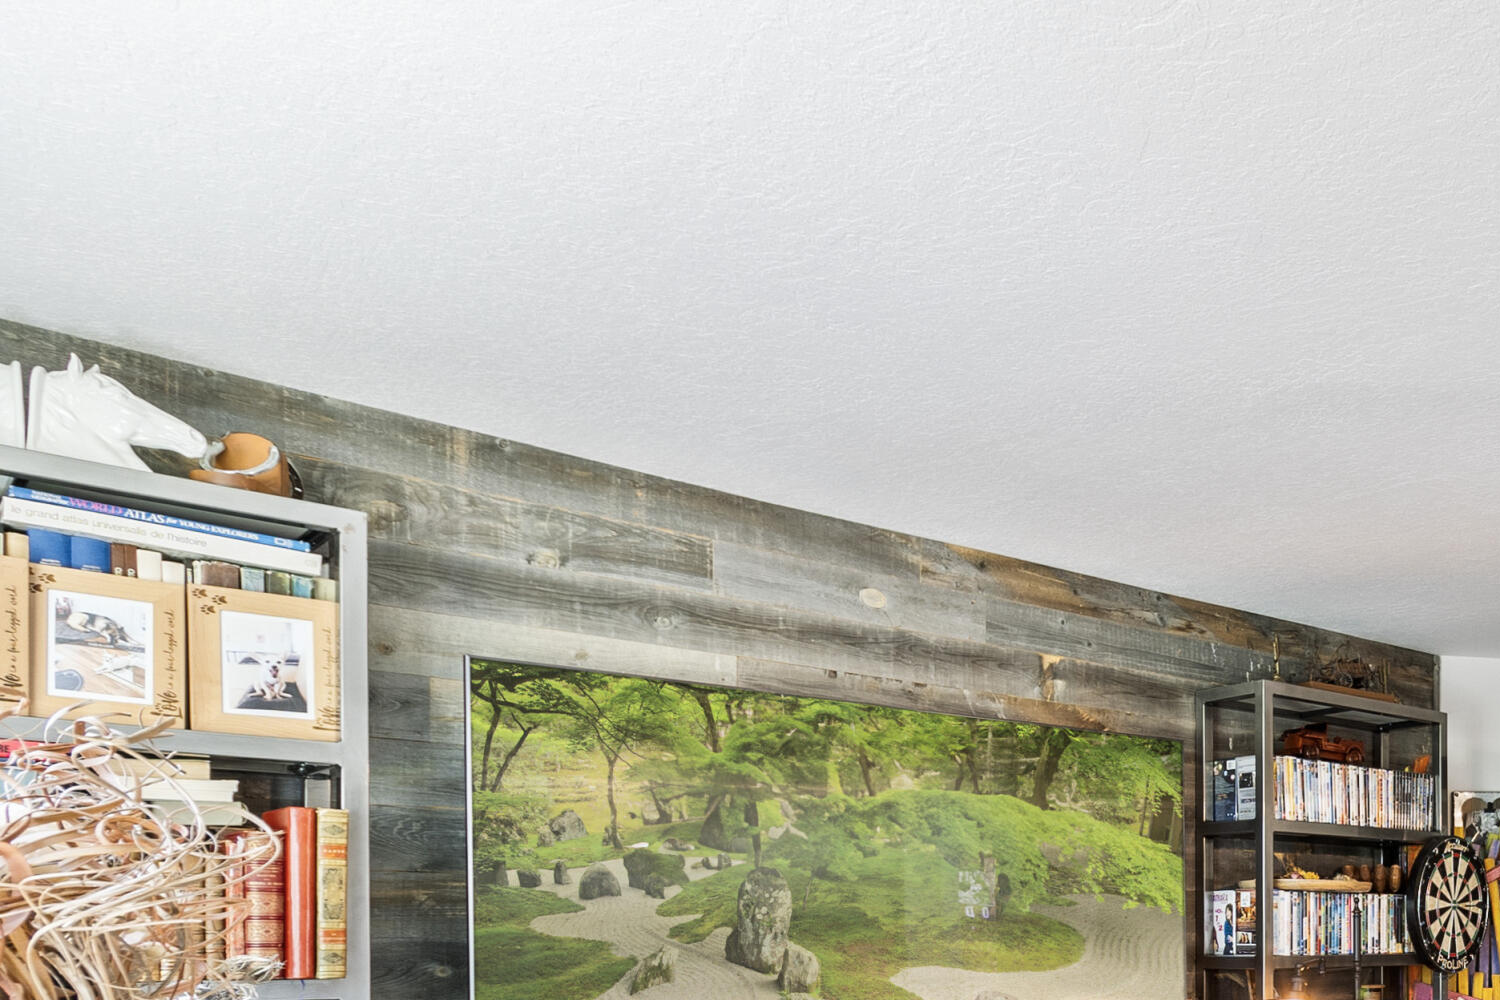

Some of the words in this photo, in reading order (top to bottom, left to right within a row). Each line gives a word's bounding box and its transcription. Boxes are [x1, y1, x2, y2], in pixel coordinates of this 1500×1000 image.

[25, 508, 59, 521] grand
[68, 497, 123, 516] WORLD
[123, 508, 165, 524] ATLAS
[1437, 955, 1469, 972] PROLINE
